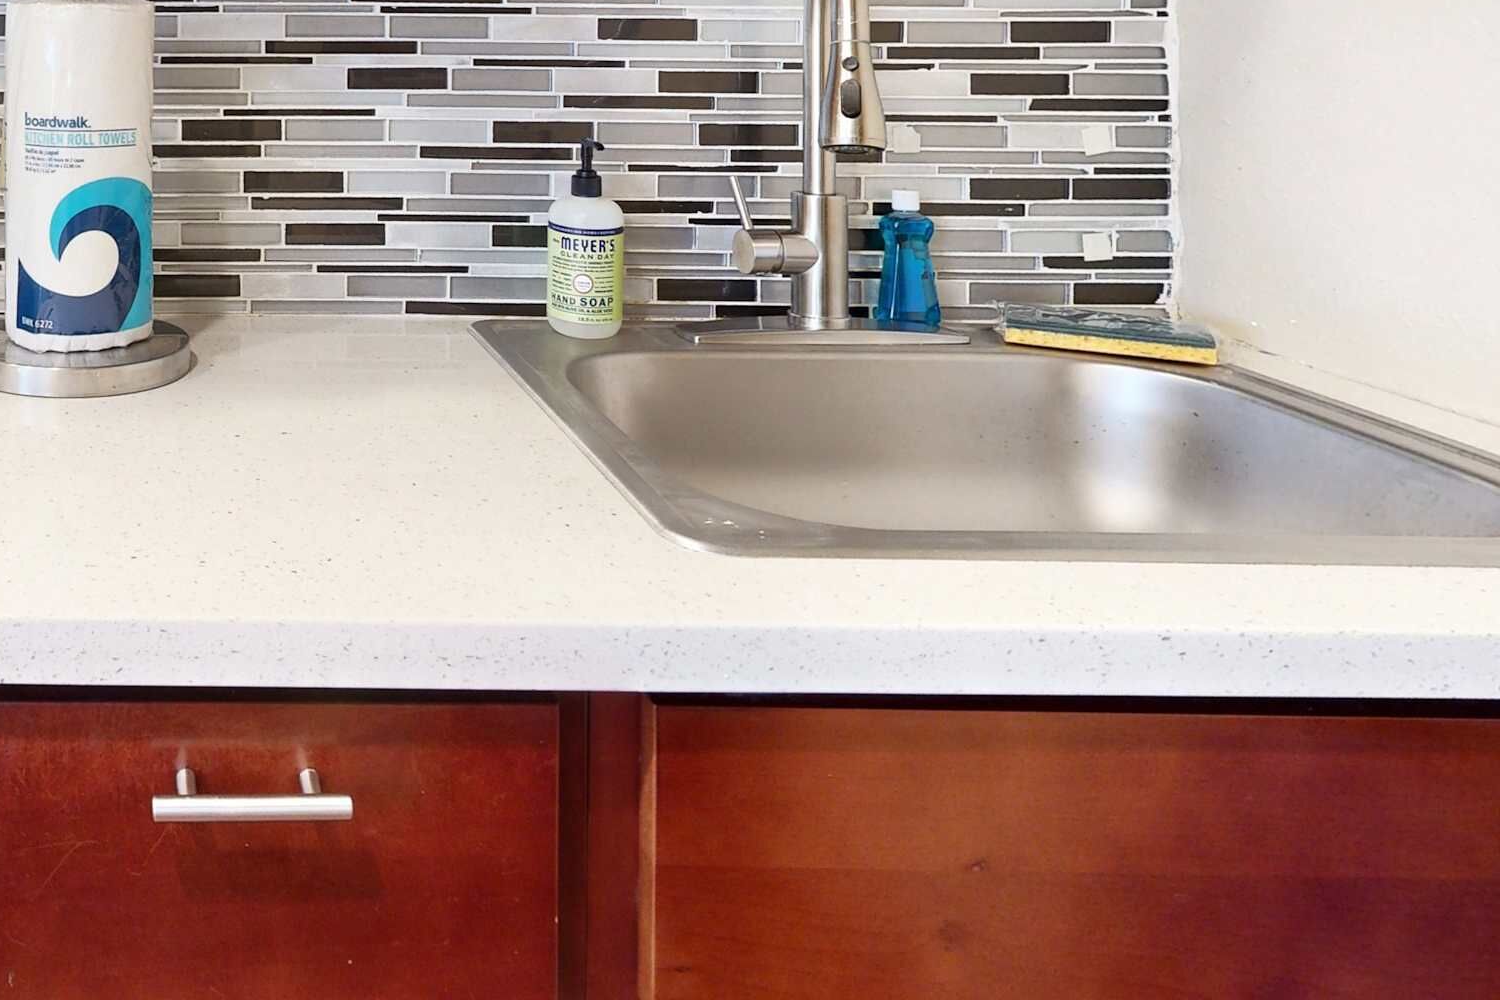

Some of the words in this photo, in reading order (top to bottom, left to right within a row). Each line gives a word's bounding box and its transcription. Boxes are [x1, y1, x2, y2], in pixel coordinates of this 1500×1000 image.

[24, 131, 64, 144] KITCHEN
[67, 133, 94, 145] ROLL
[98, 132, 137, 145] TOWELS
[561, 236, 615, 252] MEYER'S
[560, 251, 594, 260] CLEAN
[580, 297, 614, 307] SOAP
[35, 320, 53, 329] 6272
